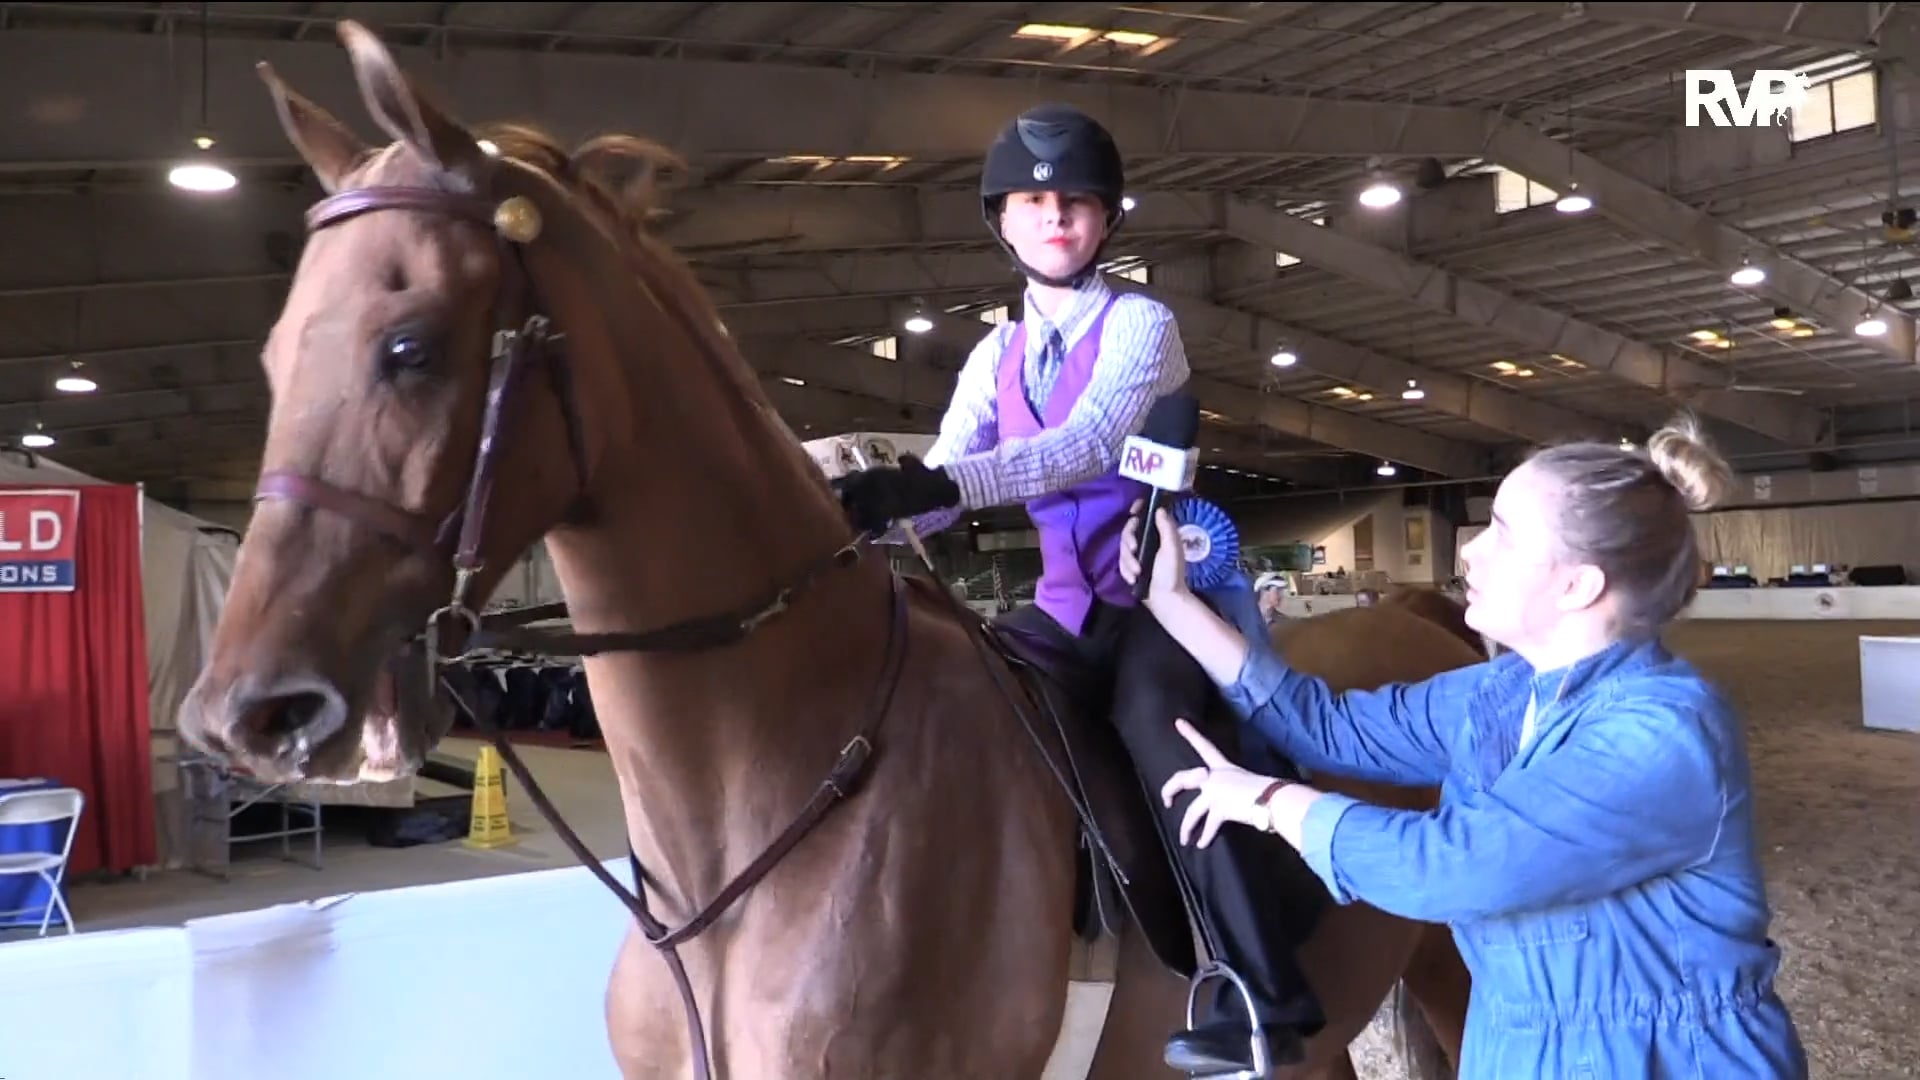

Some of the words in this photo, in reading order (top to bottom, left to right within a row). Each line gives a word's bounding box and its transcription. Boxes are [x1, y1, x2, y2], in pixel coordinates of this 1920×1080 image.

[1124, 446, 1165, 475] RVP
[0, 510, 62, 551] LD
[0, 565, 58, 583] ONS
